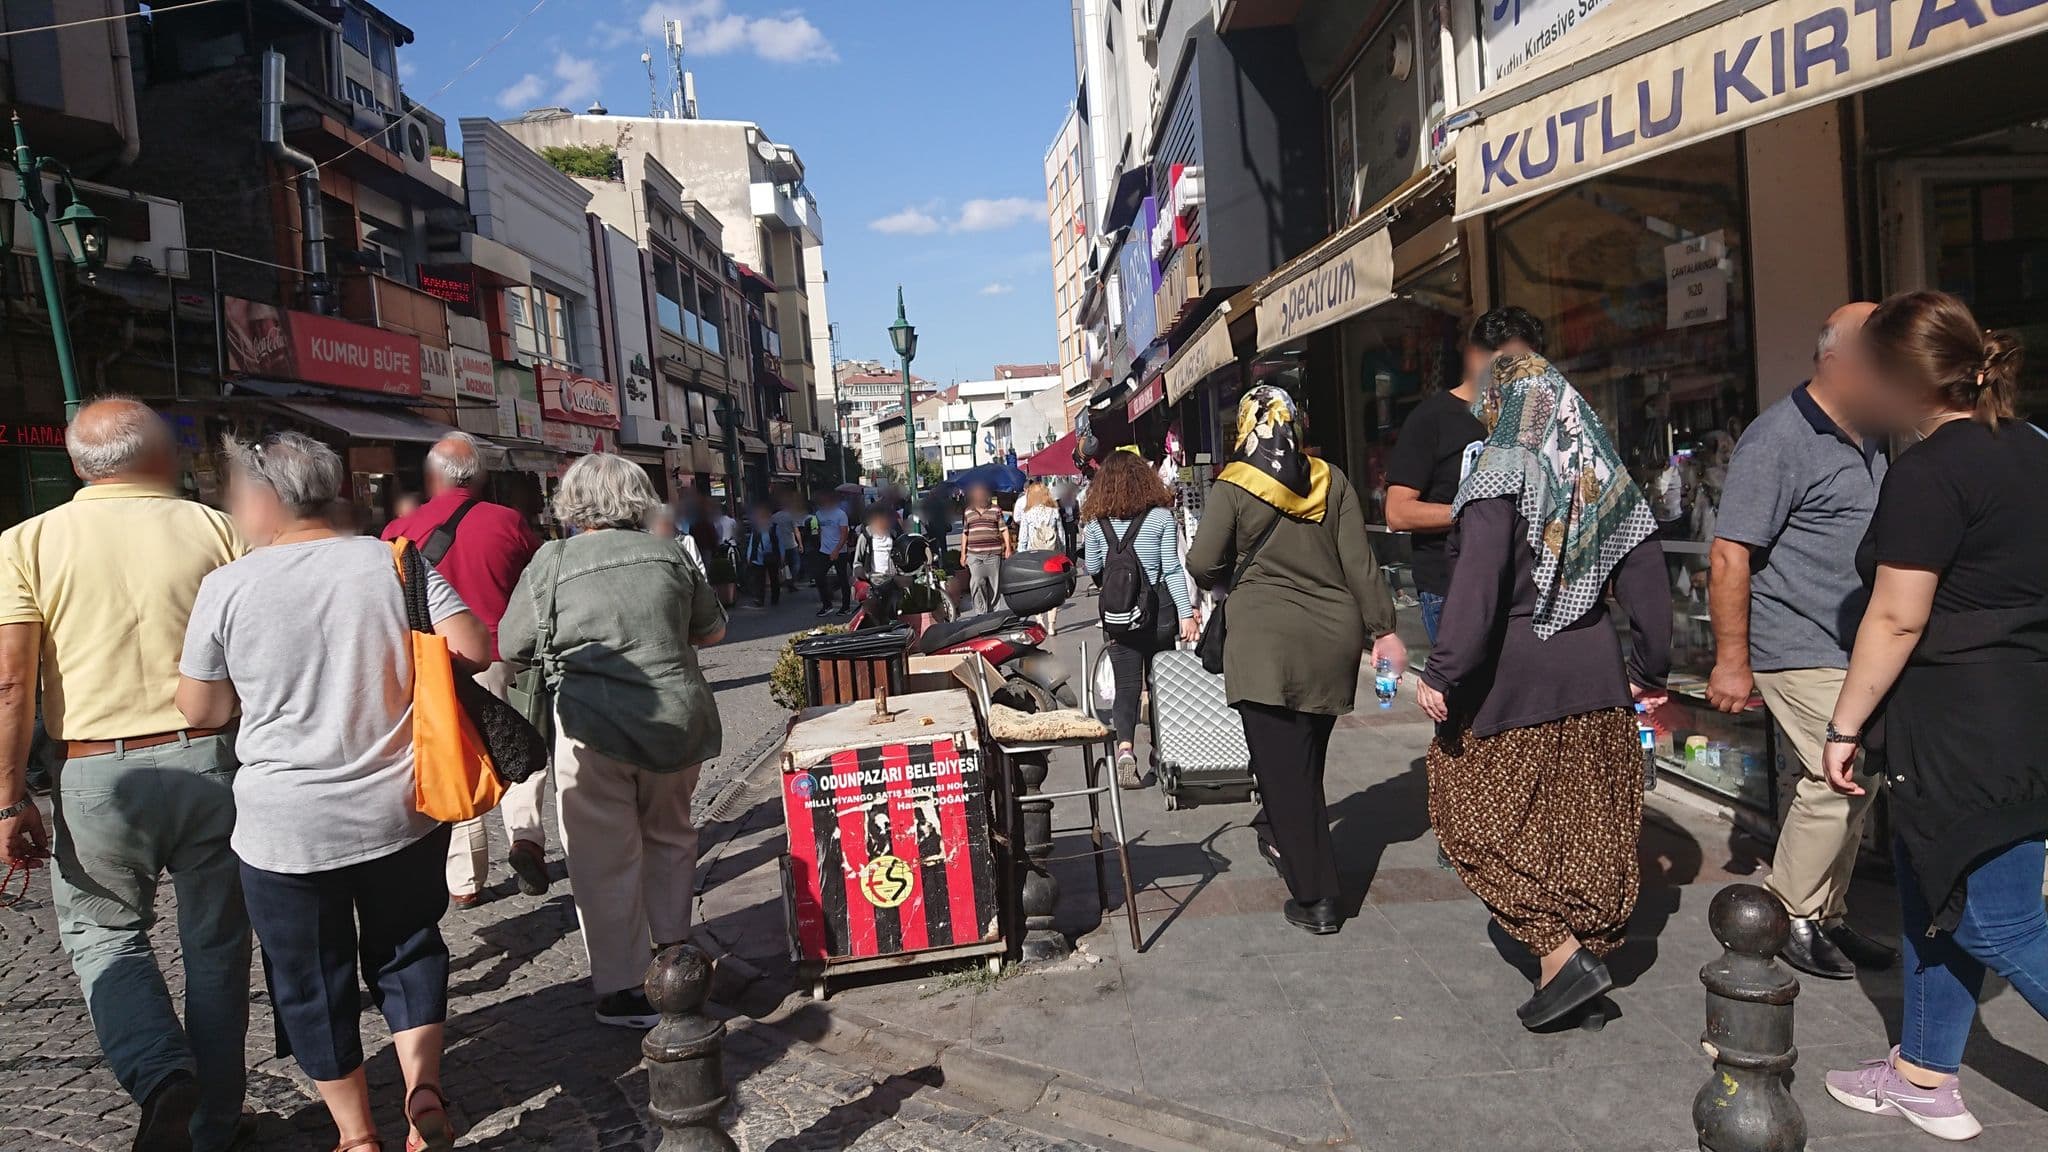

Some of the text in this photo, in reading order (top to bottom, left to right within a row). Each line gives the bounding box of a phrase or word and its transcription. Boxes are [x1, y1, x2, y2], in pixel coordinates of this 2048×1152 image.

[1525, 8, 1575, 61] Kırtasiye
[1480, 66, 1685, 194] KUTLU
[1281, 257, 1356, 337] spectrum
[311, 335, 412, 375] KUMRU BÜFE
[17, 424, 66, 444] HAMA
[820, 753, 979, 791] ODUNPAZARI BELEDİYESİ
[804, 796, 830, 809] MİLLİ
[832, 792, 874, 806] PİYANGO
[875, 789, 902, 799] SATIŞ
[904, 783, 945, 796] NOKTASI
